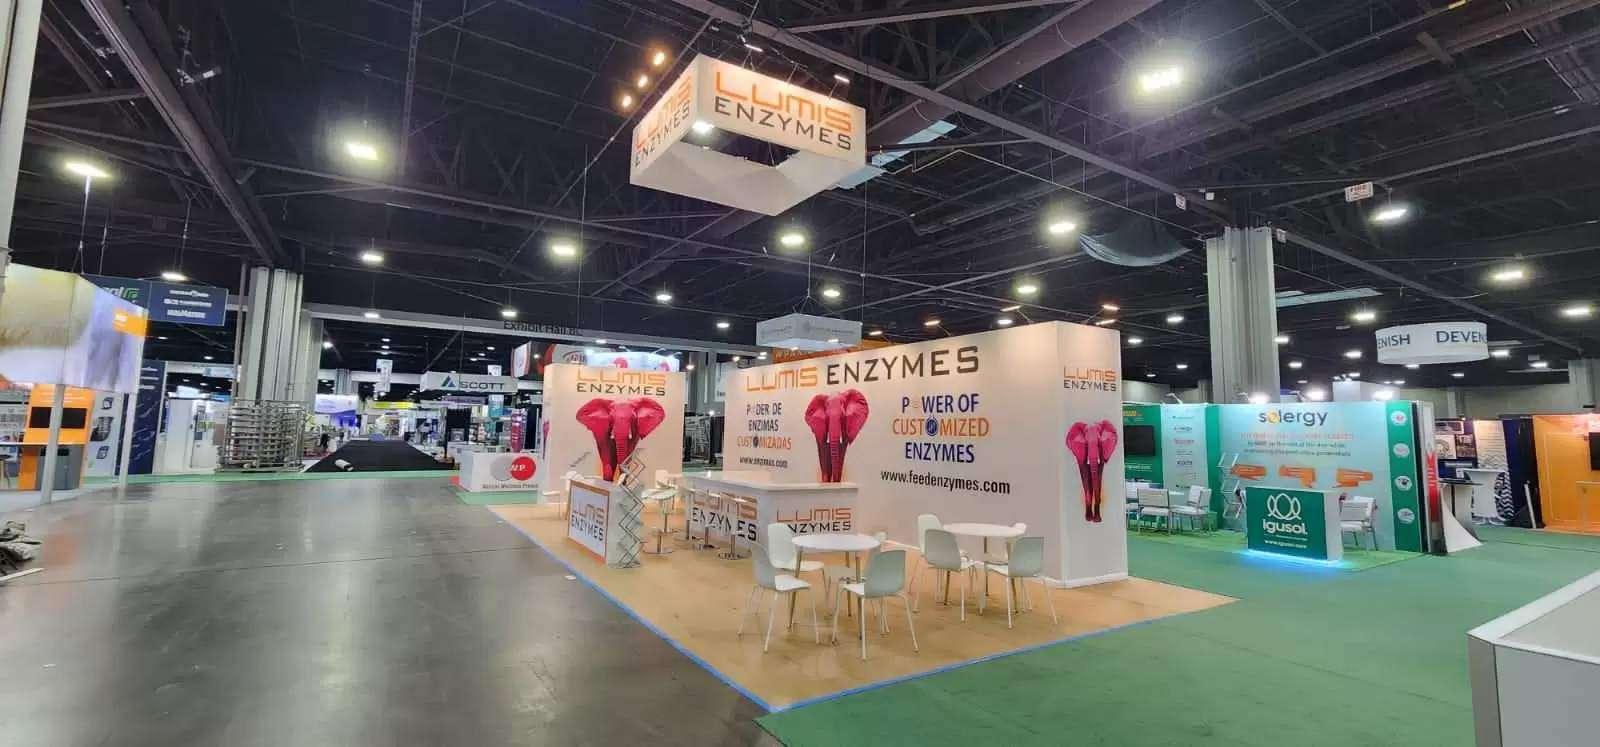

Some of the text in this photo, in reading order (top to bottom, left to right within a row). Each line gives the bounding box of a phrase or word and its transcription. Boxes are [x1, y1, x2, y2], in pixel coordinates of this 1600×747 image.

[716, 72, 852, 133] LUMIS
[714, 96, 852, 151] ENZYMES
[631, 99, 691, 169] ENZYMES
[577, 368, 667, 386] LUMIS
[746, 345, 979, 392] LUMIS ENZYMES
[1063, 366, 1117, 382] LUMIS
[459, 380, 505, 391] SCOTT
[576, 382, 666, 397] ENZYMES
[1063, 379, 1117, 392] ENZYMES
[746, 402, 783, 416] PDER DE
[902, 393, 979, 414] PWER OF
[748, 419, 780, 432] ENZIMAS
[892, 416, 990, 437] CUSTOMIZED
[1258, 408, 1329, 427] solergy
[904, 441, 976, 464] ENZYMES
[880, 469, 1011, 495] www.feedenzymes.com
[776, 507, 853, 522] LUMIS
[571, 513, 604, 542] ENZYMES
[787, 520, 852, 534] NZYMES
